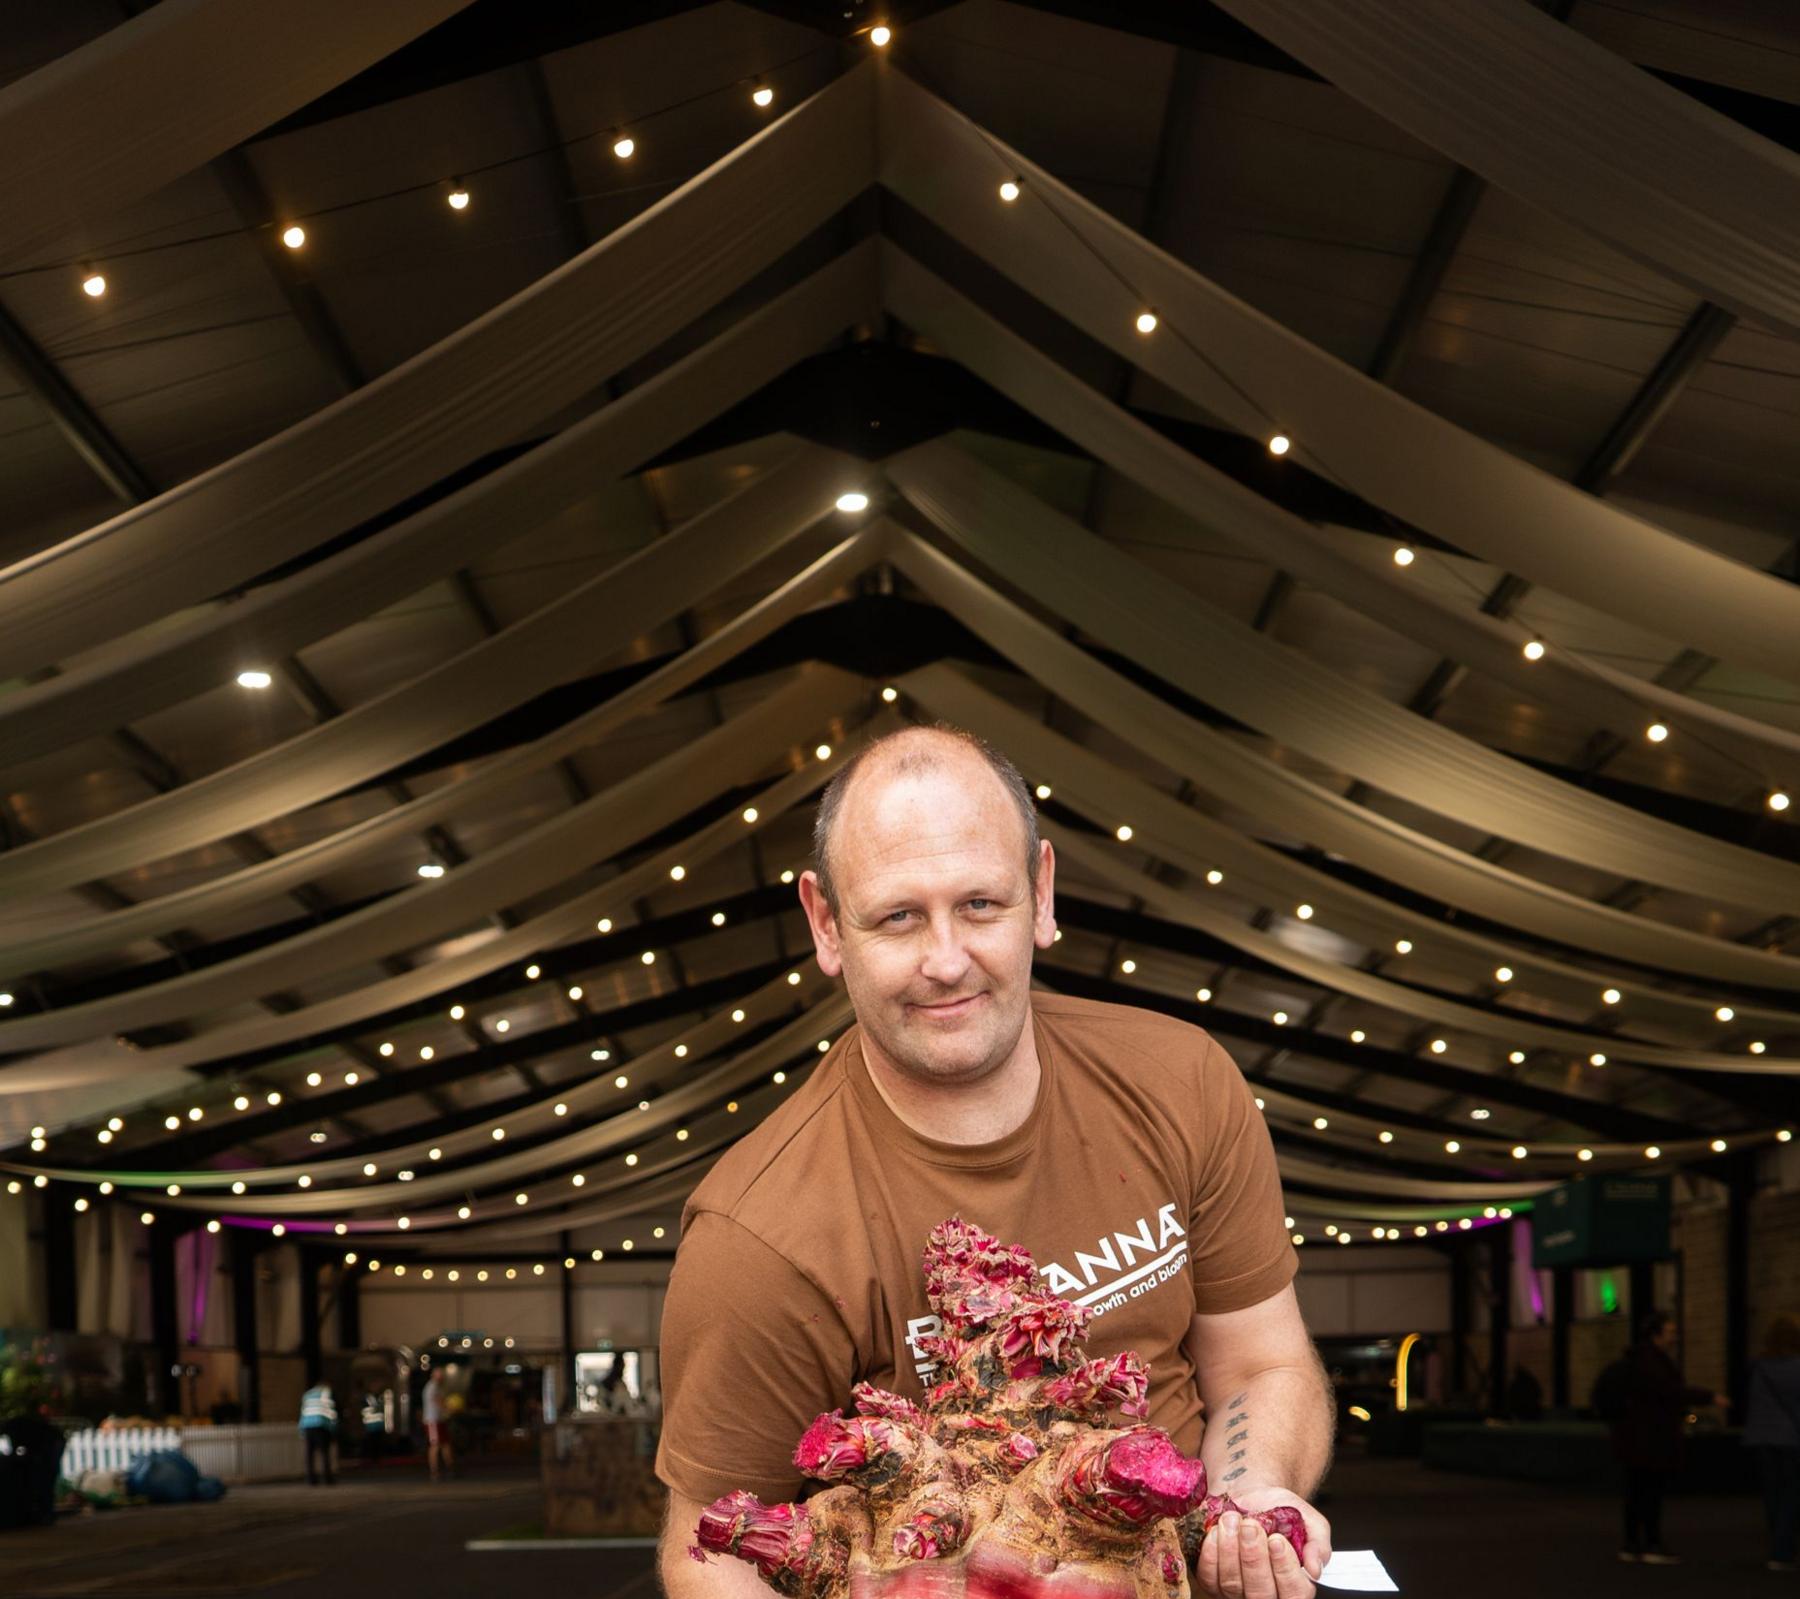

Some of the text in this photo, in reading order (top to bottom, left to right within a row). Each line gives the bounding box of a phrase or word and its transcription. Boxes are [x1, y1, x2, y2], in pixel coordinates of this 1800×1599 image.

[1093, 1253, 1188, 1317] owth and bloom
